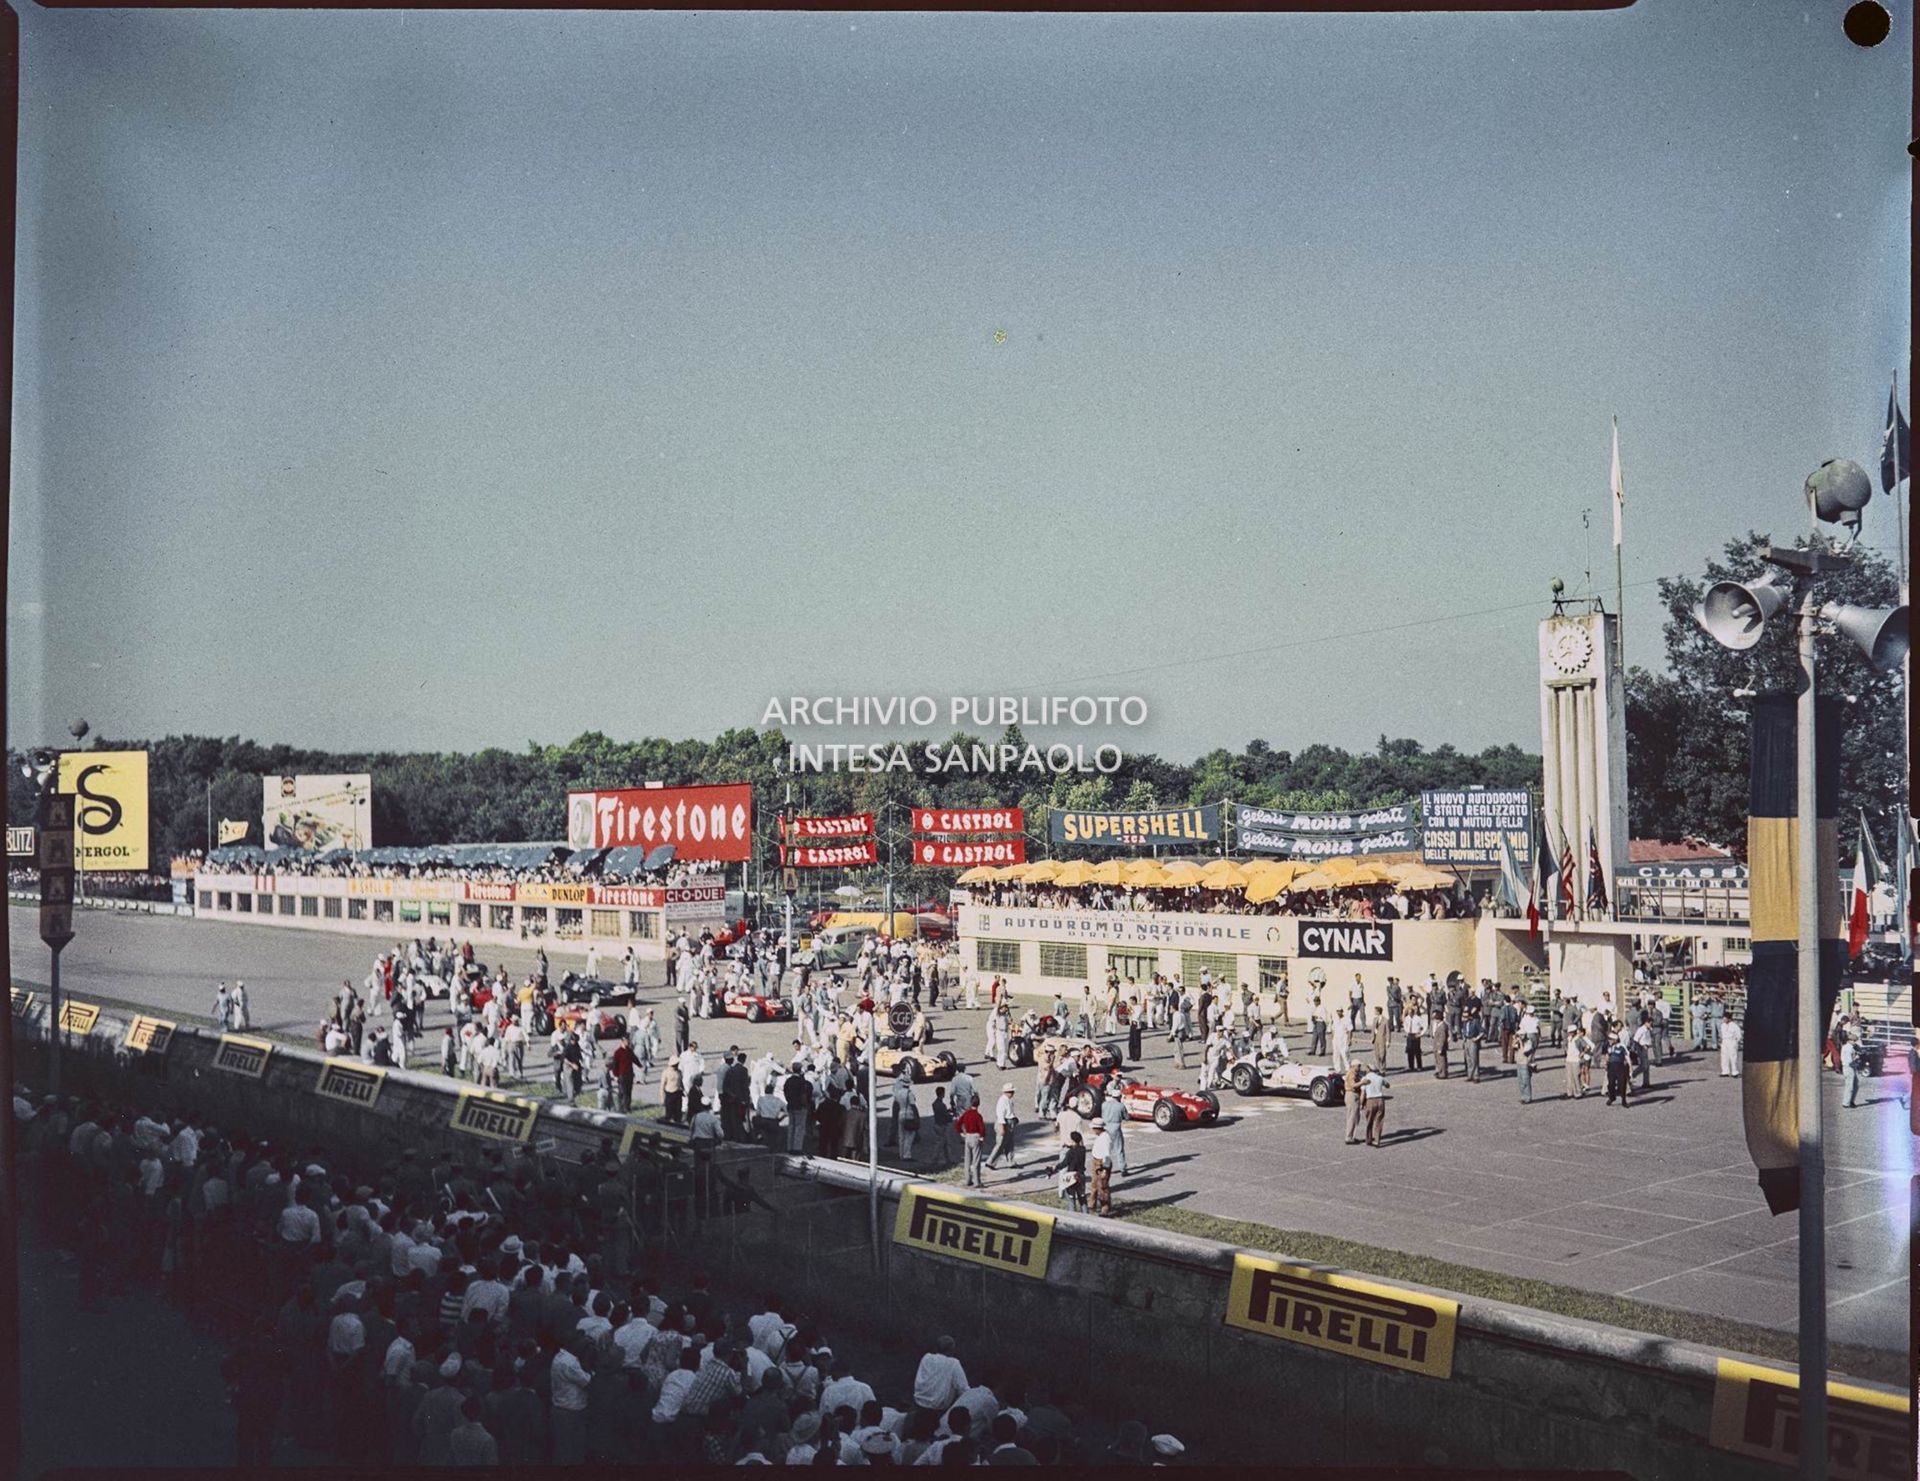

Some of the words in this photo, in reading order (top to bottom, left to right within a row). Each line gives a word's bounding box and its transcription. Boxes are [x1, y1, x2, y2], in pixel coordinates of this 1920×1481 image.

[1422, 792, 1431, 804] IL
[1433, 793, 1465, 805] NUOVO
[1468, 792, 1528, 804] AUTODROMO
[1358, 806, 1408, 830] gelati
[1434, 805, 1463, 816] STATO
[1466, 805, 1528, 816] REALIZZATO
[597, 796, 746, 848] Firestone
[806, 818, 868, 834] CASTROL
[941, 813, 1013, 831] CASTROL
[1063, 810, 1209, 842] SUPERSHELL
[1428, 816, 1445, 828] CON
[1448, 816, 1459, 828] UN
[1463, 816, 1492, 828] MUTUO
[1495, 816, 1523, 828] DELLA
[1359, 830, 1410, 854] gelati
[1424, 831, 1456, 848] CASSA
[1460, 831, 1470, 848] DI
[1473, 831, 1528, 849] RISPAMIO
[75, 846, 130, 857] NERGOL
[808, 846, 870, 864] CASTROL
[943, 844, 1015, 863] CASTROL
[1424, 849, 1447, 860] DELLE
[1448, 849, 1487, 861] PROVINCIE
[552, 889, 585, 902] DUNLOP
[594, 887, 655, 906] Firestone
[1005, 917, 1123, 933] AUTODROMO
[1136, 922, 1252, 940] NAZIONALE
[1068, 931, 1173, 942] DIREZIONE
[1303, 927, 1385, 955] CYNAR
[891, 1012, 911, 1025] CGE
[219, 1042, 265, 1071] PIRELLI
[321, 1064, 381, 1101] PIRELLI
[461, 1095, 531, 1138] PIRELLI
[909, 1195, 1040, 1266] PIRELLI
[1248, 1268, 1438, 1363] PIRELLI
